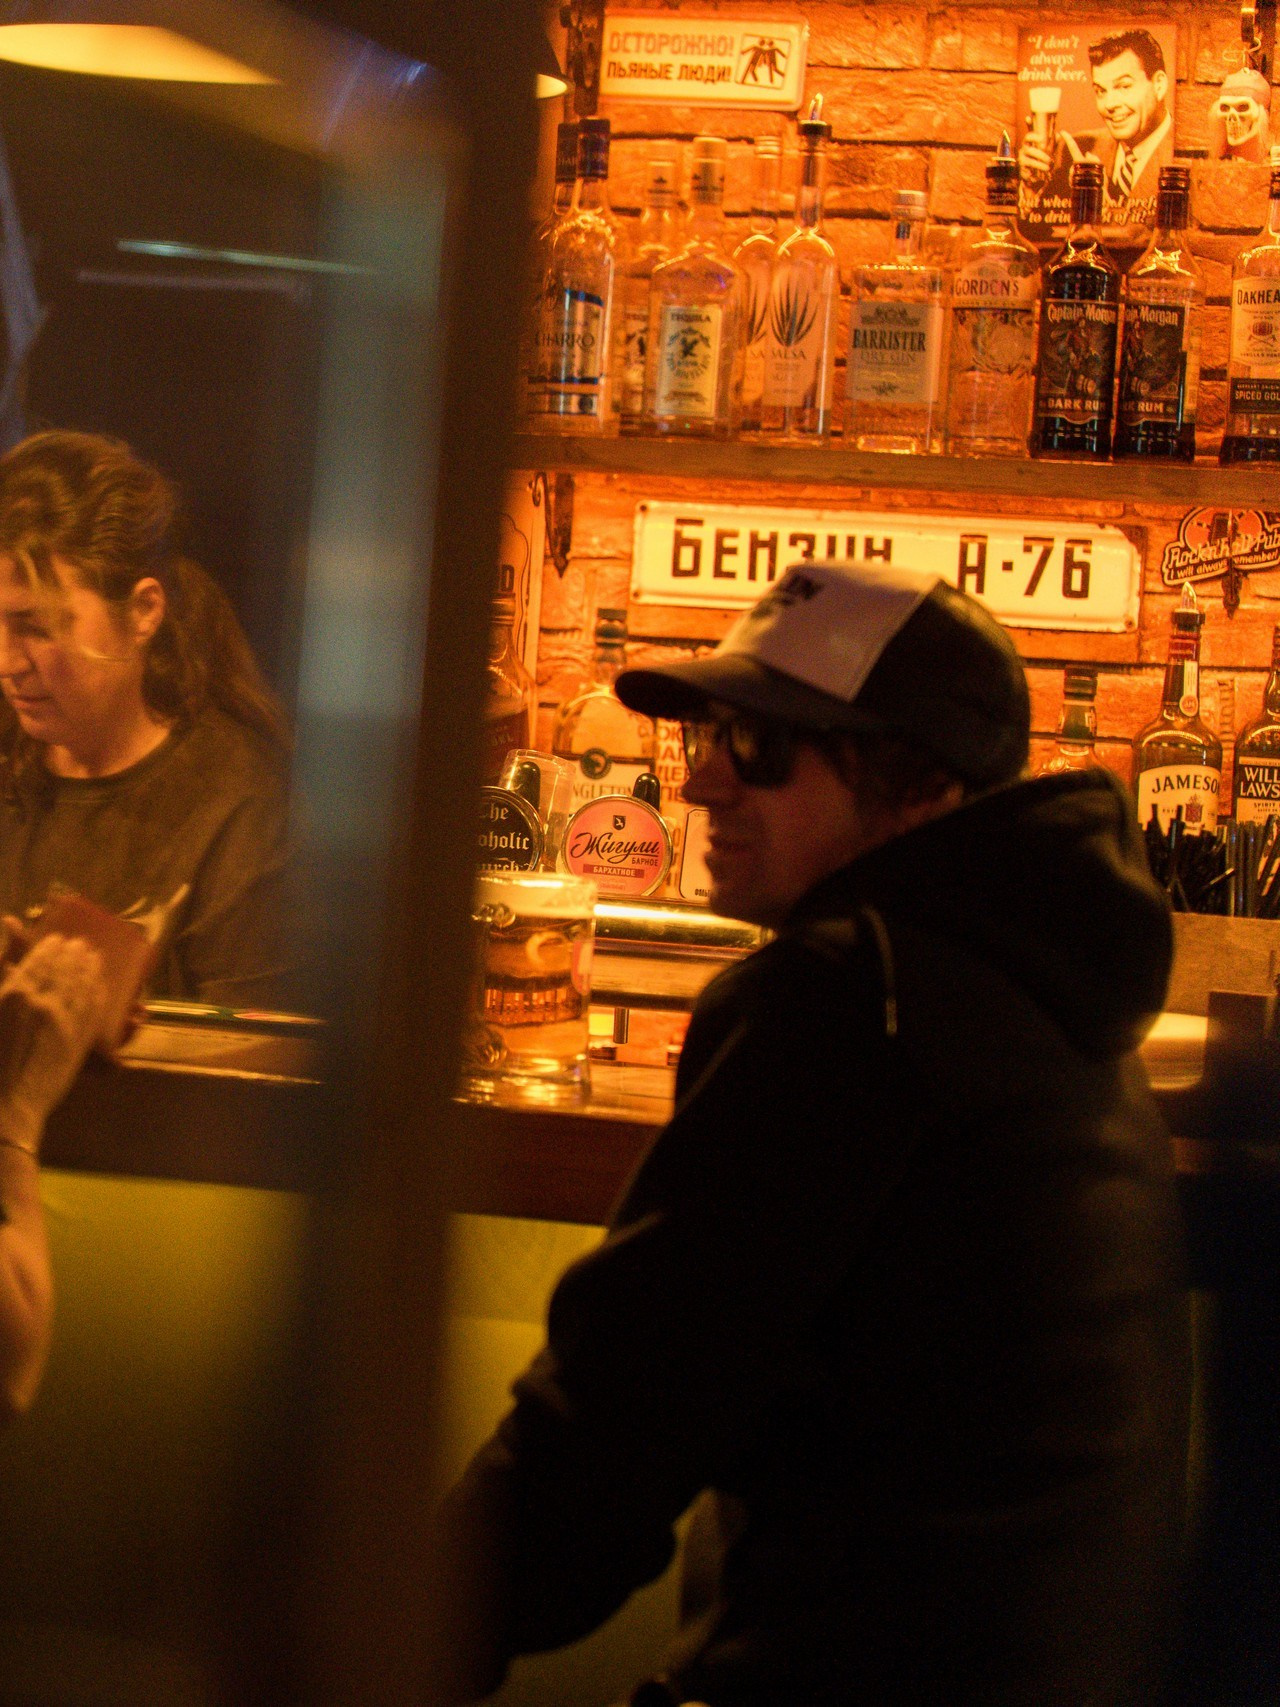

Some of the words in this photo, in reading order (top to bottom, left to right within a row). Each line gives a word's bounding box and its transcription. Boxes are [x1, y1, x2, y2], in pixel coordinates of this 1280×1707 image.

[609, 31, 735, 58] ОСТОРОЖНО!
[1030, 51, 1074, 69] always
[607, 61, 673, 80] ПЬЯНЫЕ
[676, 64, 732, 84] ЛЮДИ!
[1017, 67, 1052, 82] drink
[1044, 210, 1072, 223] drin
[1047, 303, 1083, 323] Captain
[1139, 305, 1179, 327] Morgan
[852, 328, 927, 352] BARRISTER
[1047, 398, 1081, 410] DARK
[1137, 401, 1165, 413] RUM
[1232, 549, 1279, 564] emember!
[479, 830, 530, 851] oholic
[570, 832, 660, 864] Жигули
[631, 857, 659, 867] БАРНОЕ
[593, 866, 636, 877] БАРХАТНОЕ
